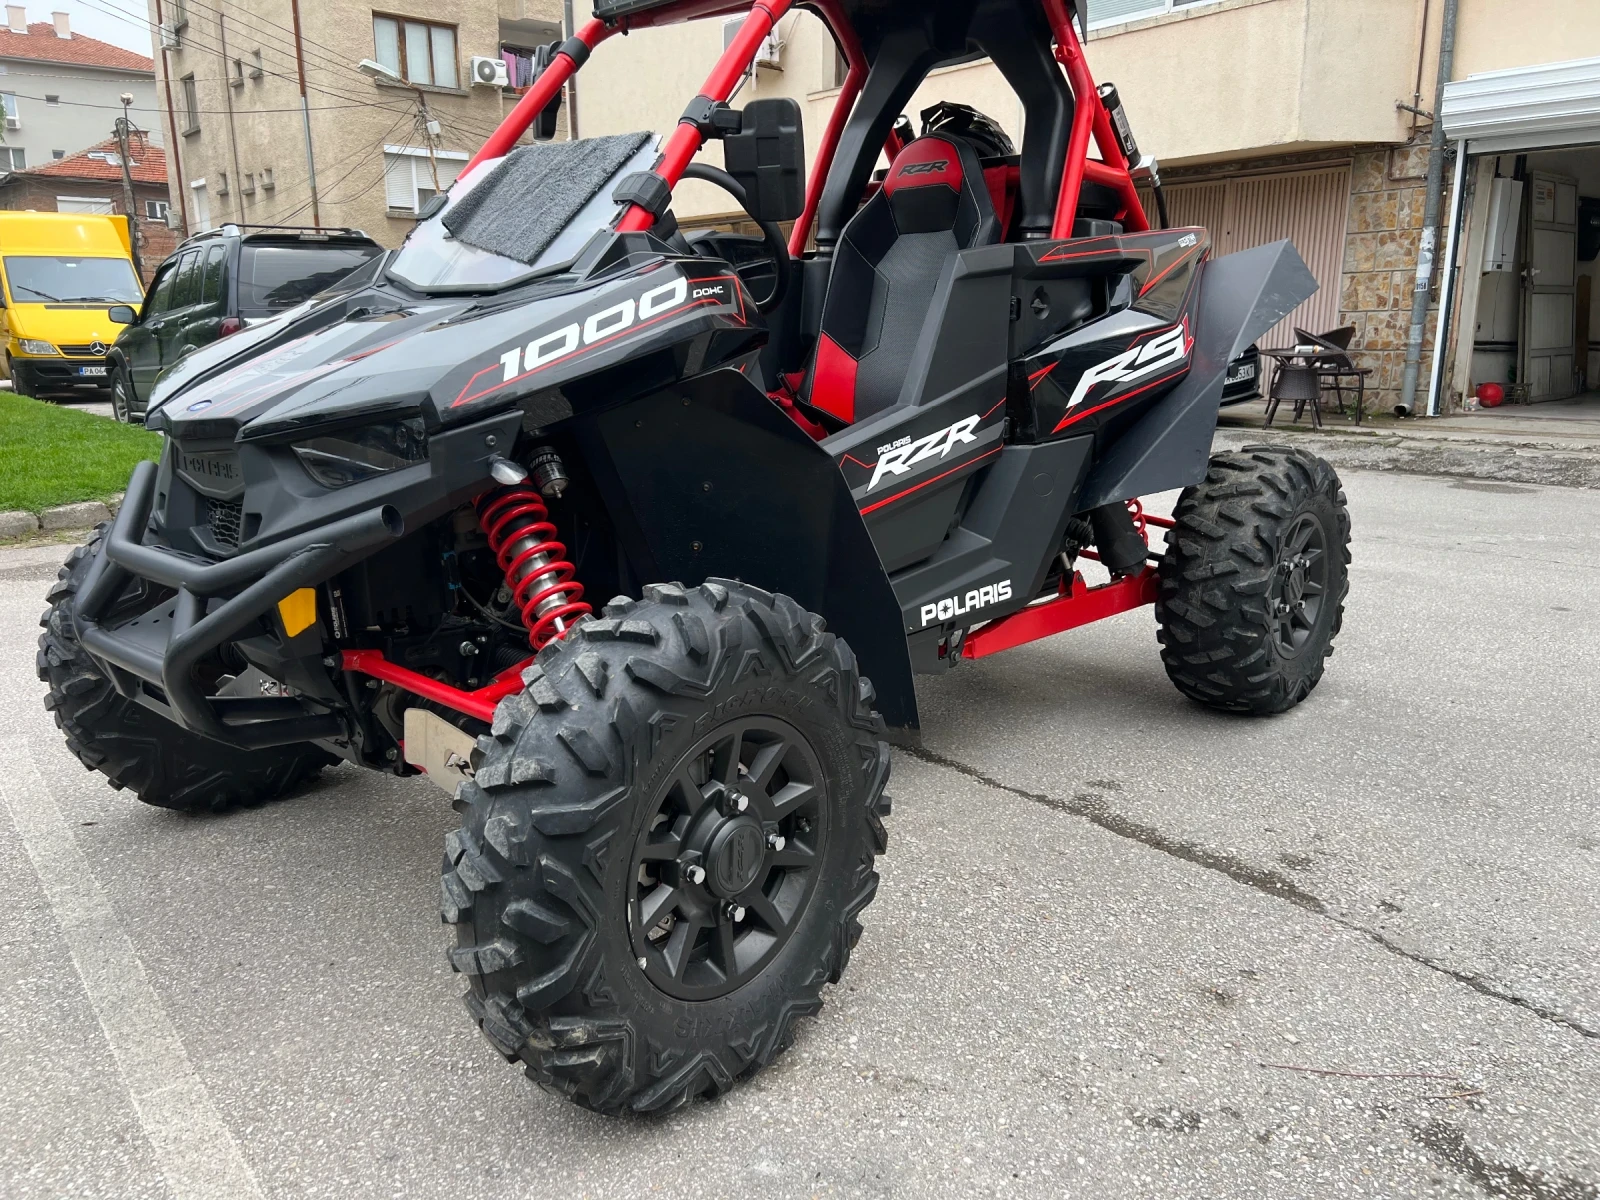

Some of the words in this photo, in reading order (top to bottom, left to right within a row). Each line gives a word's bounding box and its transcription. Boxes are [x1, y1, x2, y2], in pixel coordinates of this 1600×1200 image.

[897, 160, 949, 178] RZR
[692, 285, 724, 299] DOHC
[499, 276, 688, 382] 1000
[865, 413, 981, 494] RZR
[876, 435, 912, 455] POLARIS
[921, 579, 1012, 627] POLARIS
